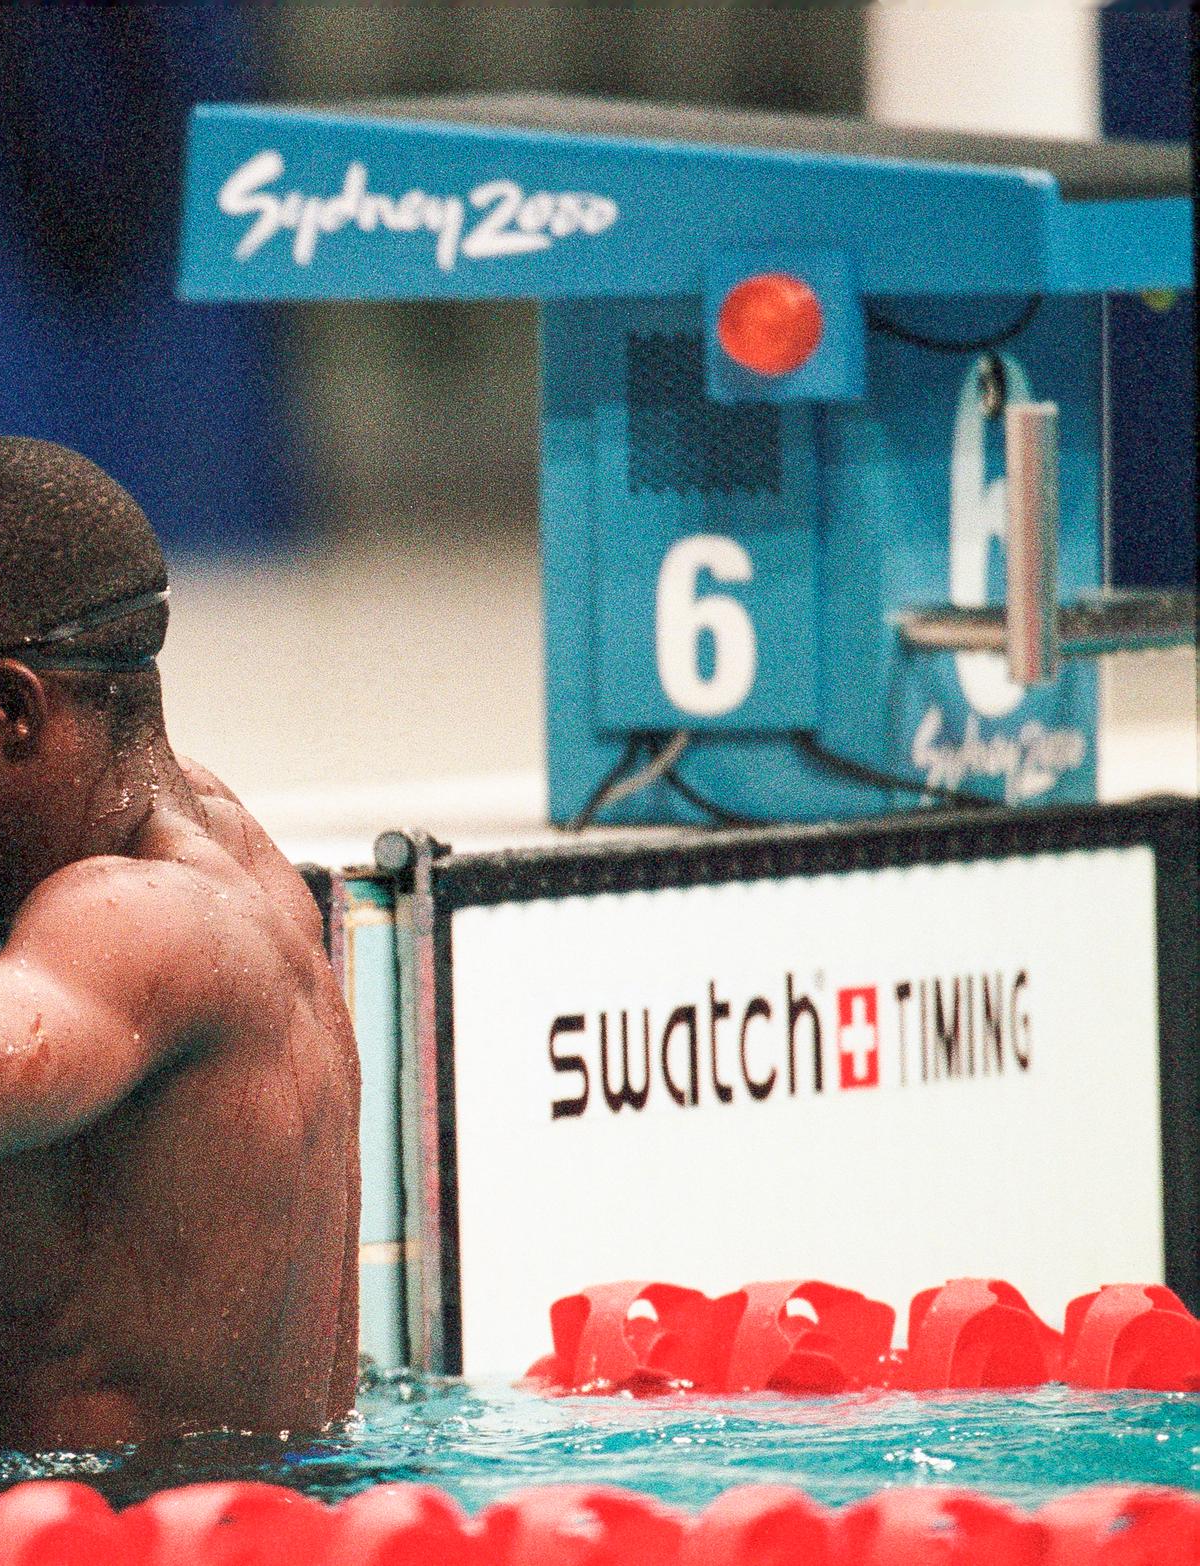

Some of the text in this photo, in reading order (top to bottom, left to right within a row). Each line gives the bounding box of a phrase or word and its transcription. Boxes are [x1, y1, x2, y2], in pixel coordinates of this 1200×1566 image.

[218, 150, 619, 271] Sydney 2000
[656, 533, 757, 716] 6
[549, 968, 1032, 1121] swatch TIMING
